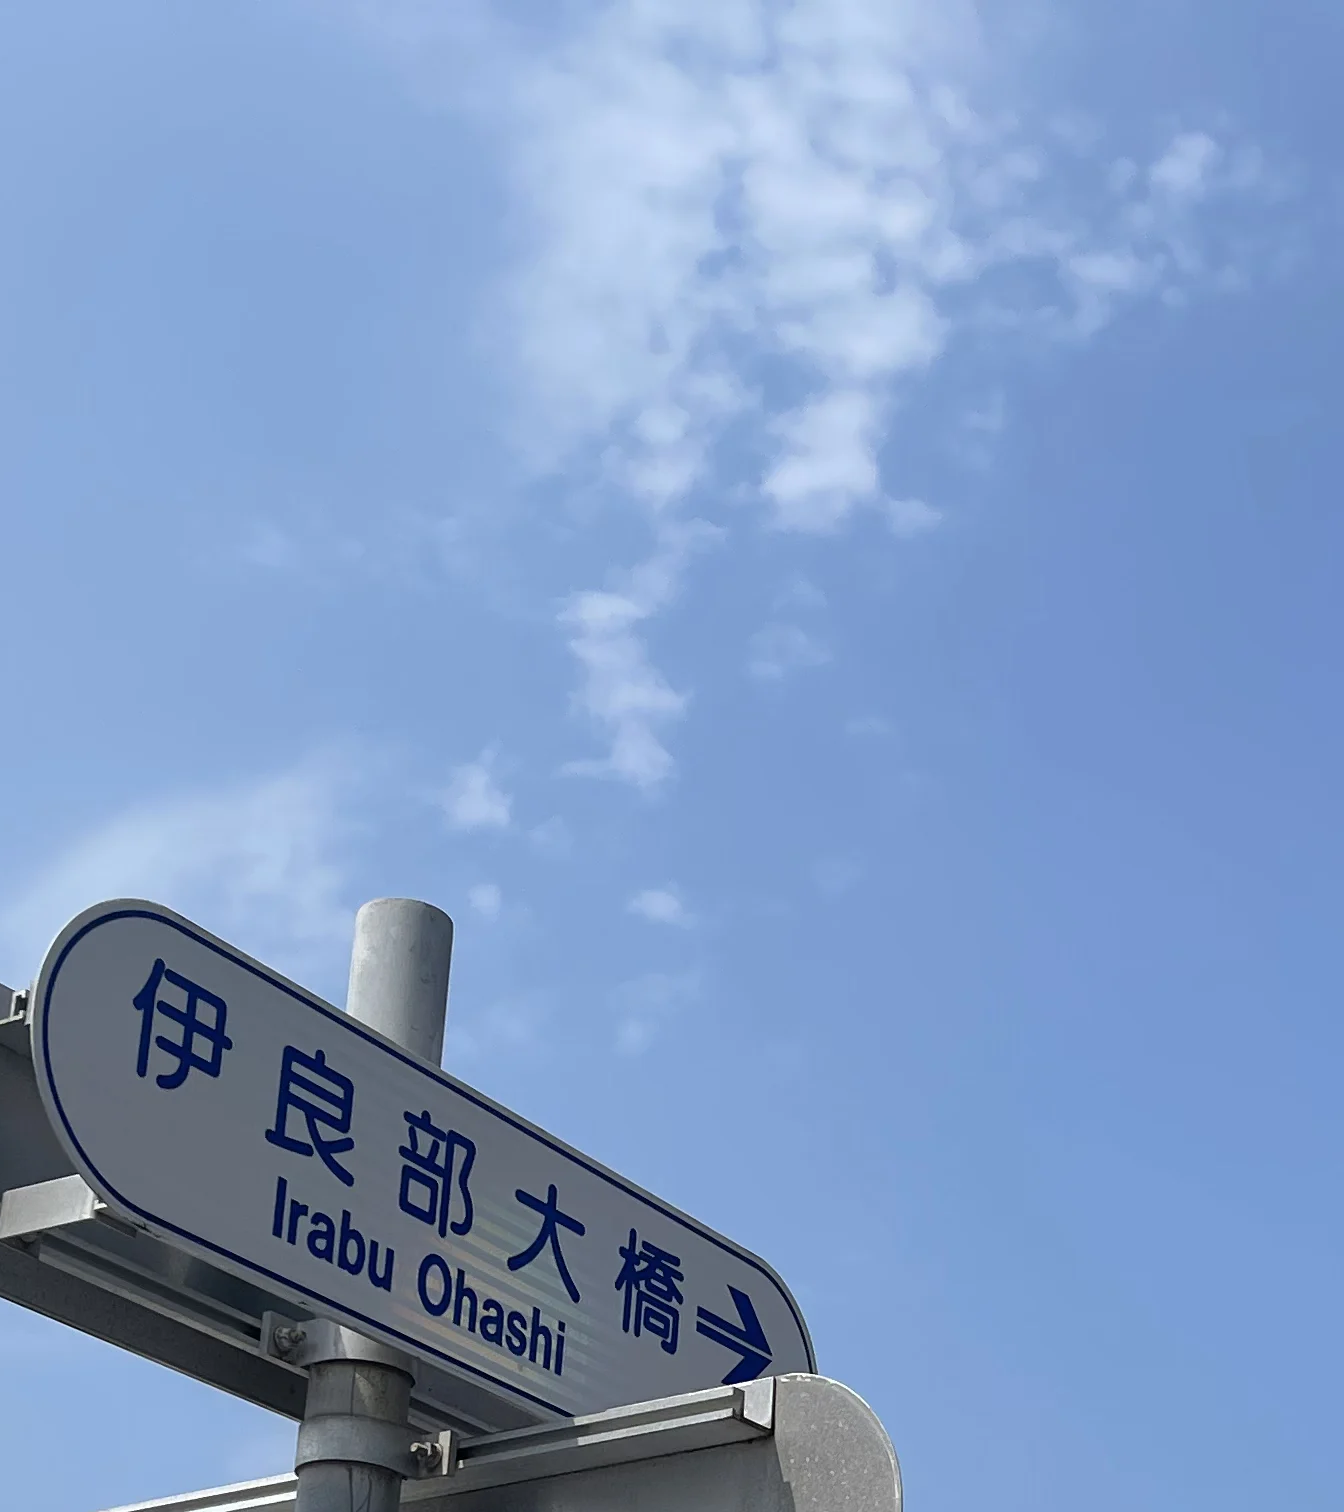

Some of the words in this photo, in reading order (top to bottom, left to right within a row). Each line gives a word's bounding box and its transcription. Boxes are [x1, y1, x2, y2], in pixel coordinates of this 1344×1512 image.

[132, 957, 685, 1356] 伊良部大橋
[271, 1176, 395, 1291] Irabu
[417, 1253, 567, 1377] Ohashi
